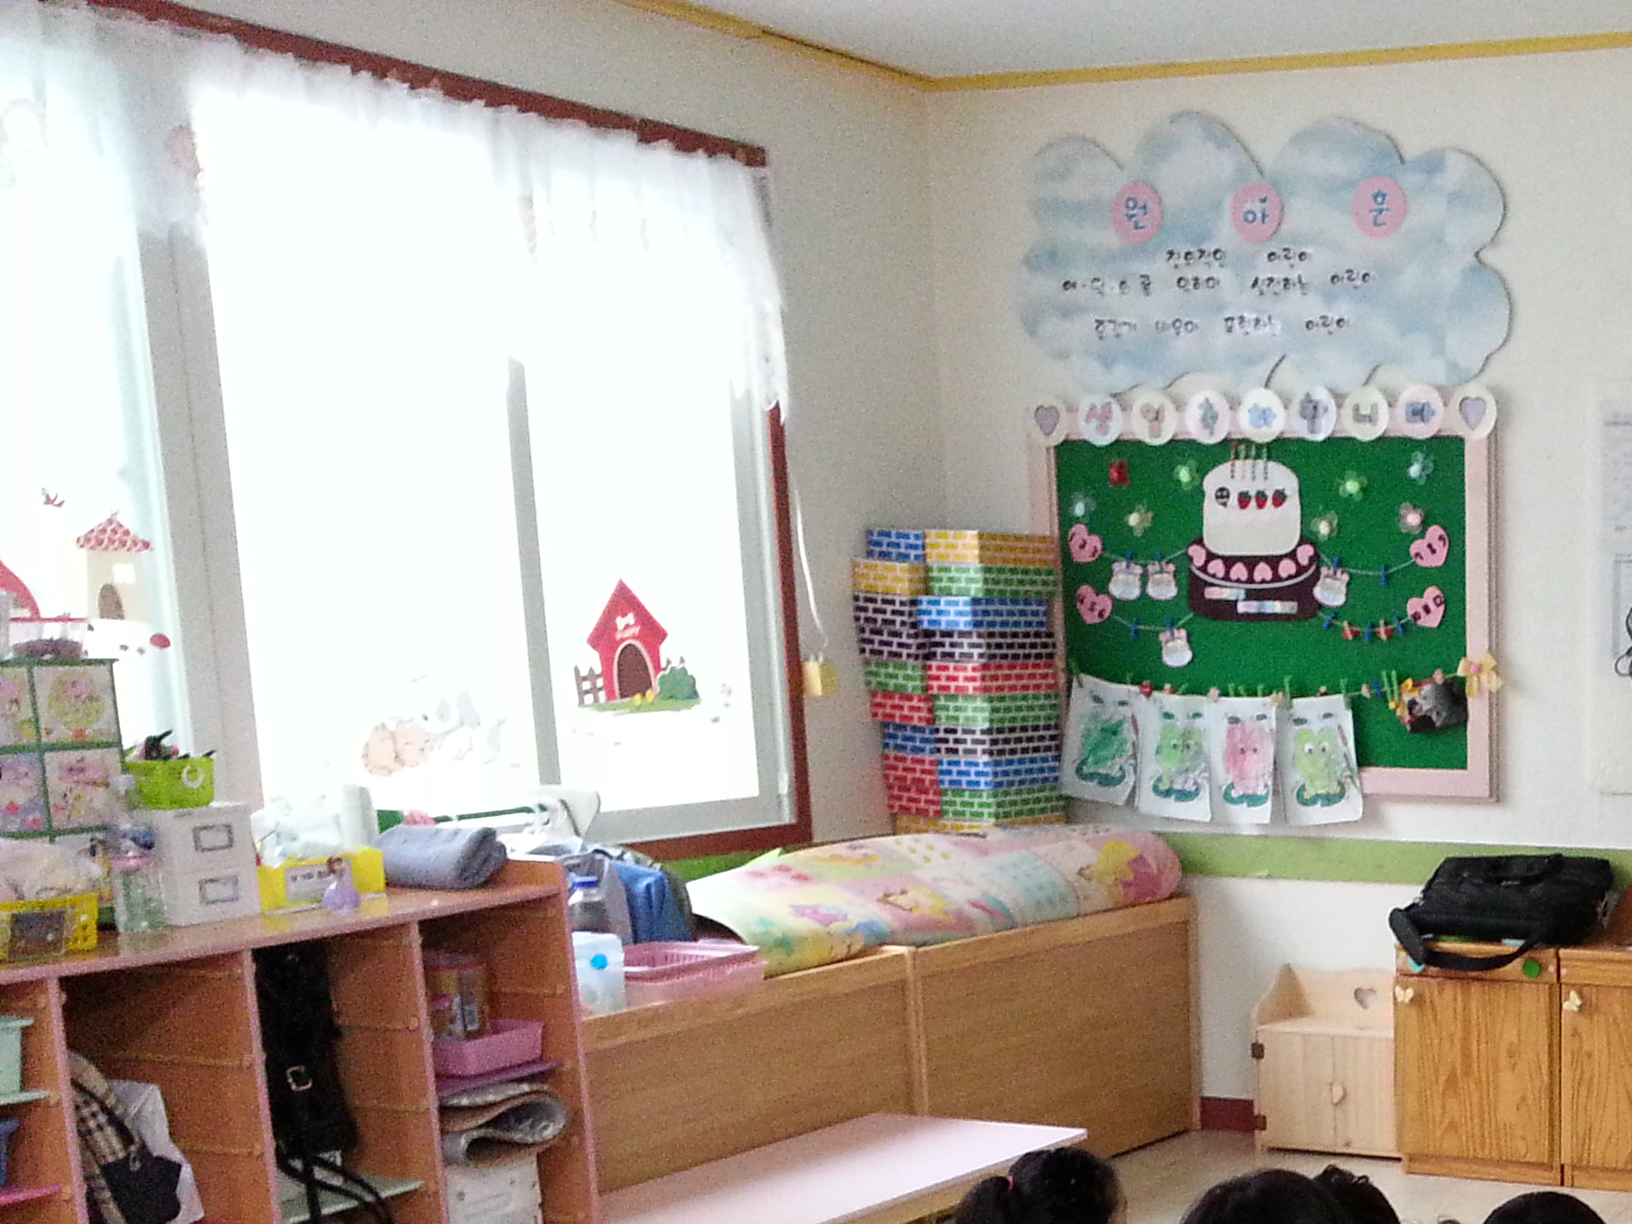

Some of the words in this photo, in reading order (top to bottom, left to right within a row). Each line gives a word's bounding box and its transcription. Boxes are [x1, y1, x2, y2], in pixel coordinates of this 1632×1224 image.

[1266, 246, 1310, 269] 어린이
[1330, 268, 1374, 290] 어린이
[1305, 313, 1350, 335] 어린이
